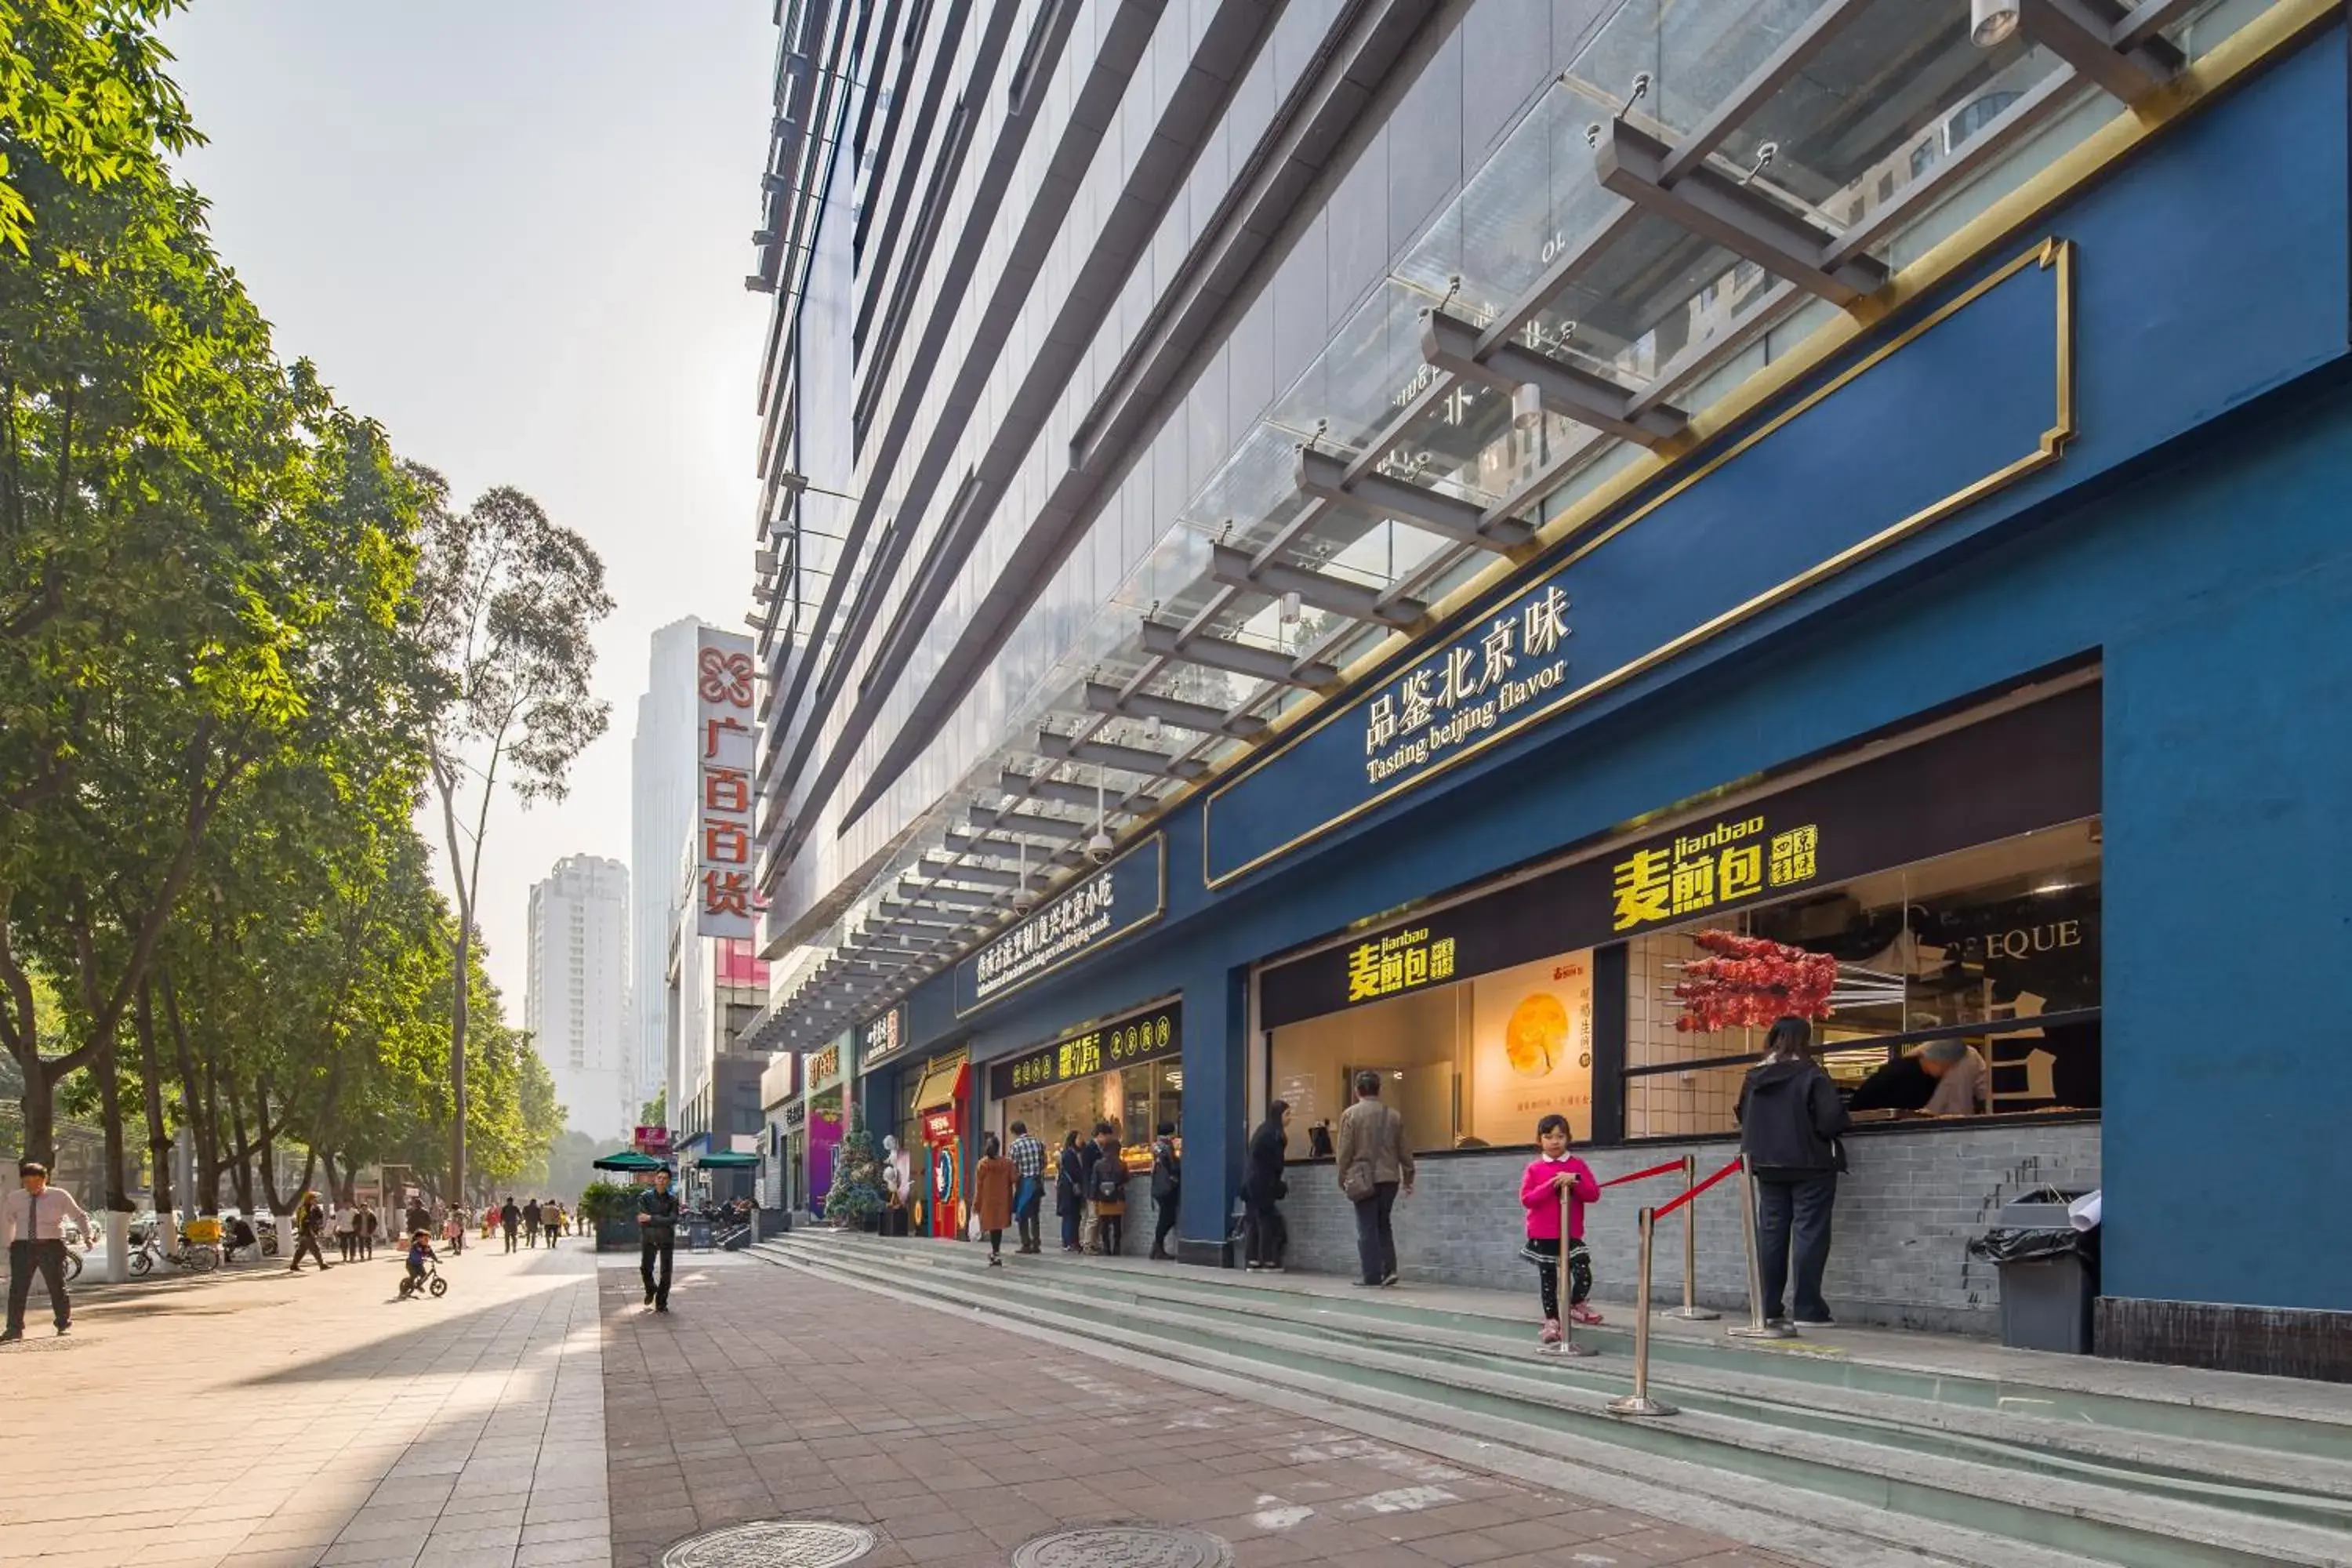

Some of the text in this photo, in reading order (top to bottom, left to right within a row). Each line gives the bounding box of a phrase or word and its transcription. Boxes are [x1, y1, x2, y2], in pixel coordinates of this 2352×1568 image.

[1367, 586, 1572, 756] 品鉴北京味
[1367, 659, 1567, 784] Tasting beijing flavor
[703, 716, 750, 920] 广百百货
[1673, 815, 1764, 864] jianbao
[1613, 844, 1762, 931] 麦煎包
[1348, 943, 1428, 1003] 麦煎包
